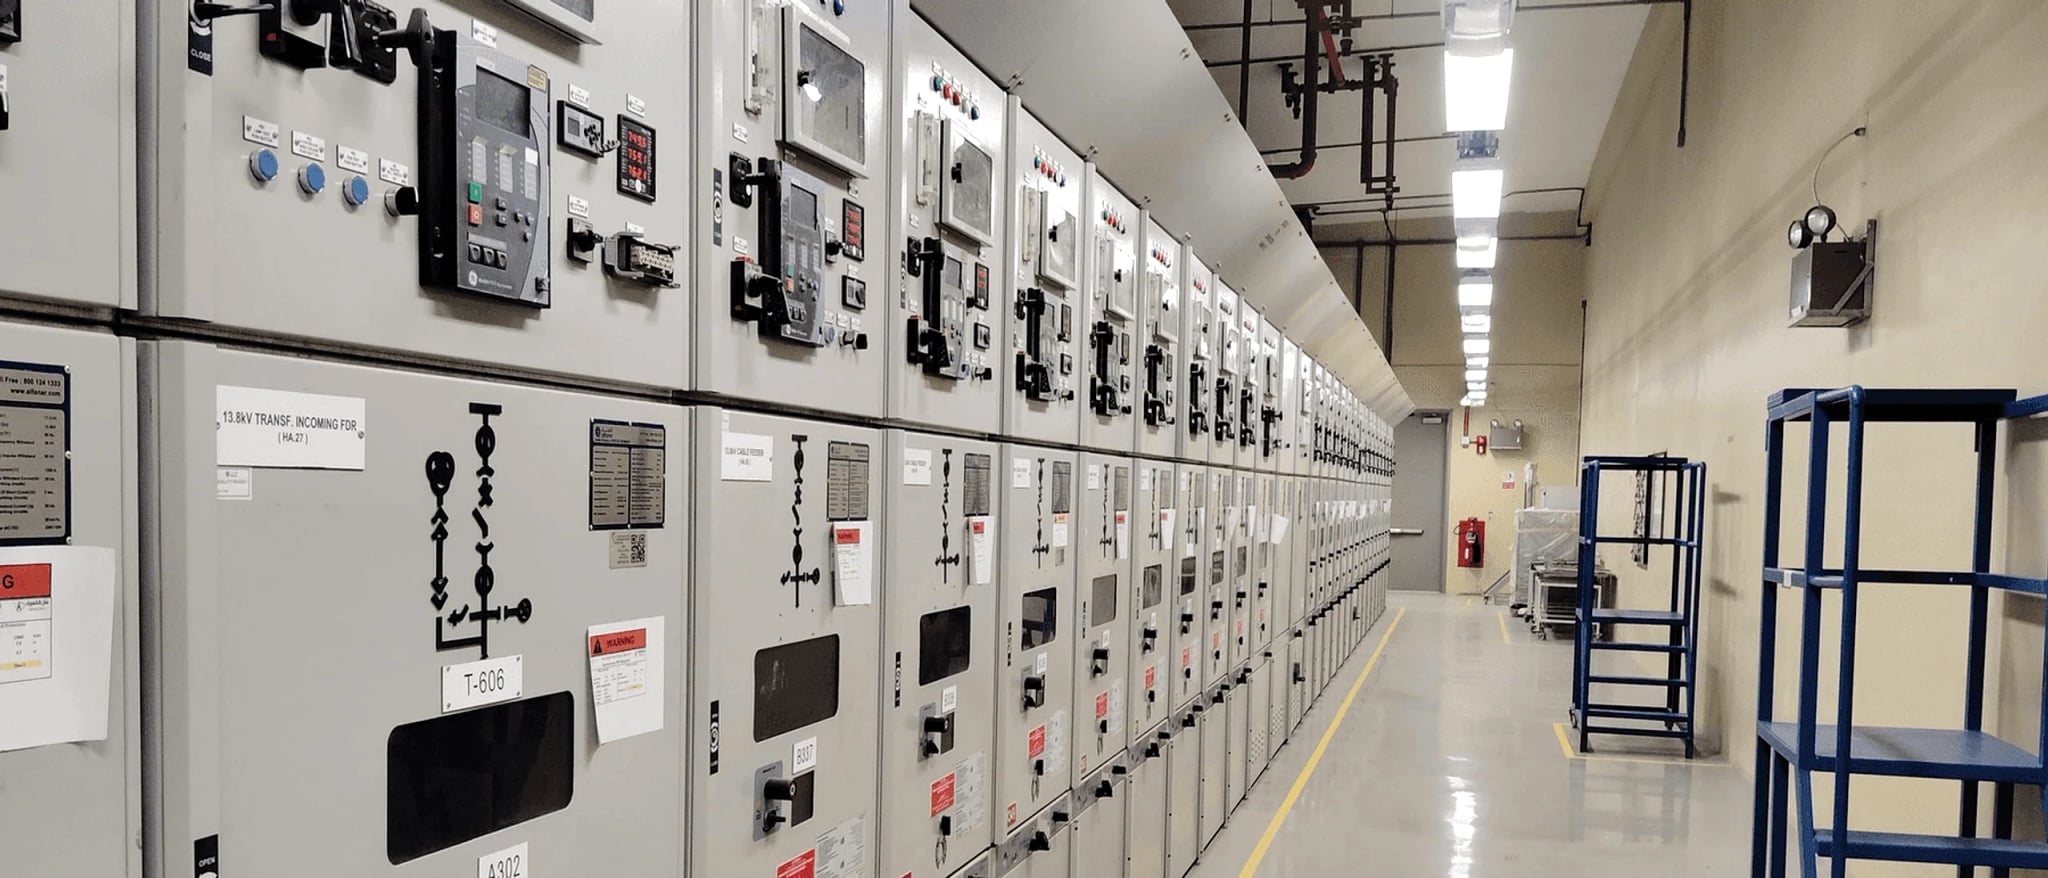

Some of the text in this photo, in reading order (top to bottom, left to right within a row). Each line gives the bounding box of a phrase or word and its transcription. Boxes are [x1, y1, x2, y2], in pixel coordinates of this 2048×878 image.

[190, 48, 211, 62] CLOSE
[4, 376, 18, 384] Free
[223, 410, 357, 431] 13.8kV TRANSF. INCOMING FDR
[606, 635, 635, 648] WARNING
[464, 668, 504, 696] T-606
[797, 744, 813, 765] B337
[198, 856, 216, 867] OPEN
[488, 855, 520, 878] A302
